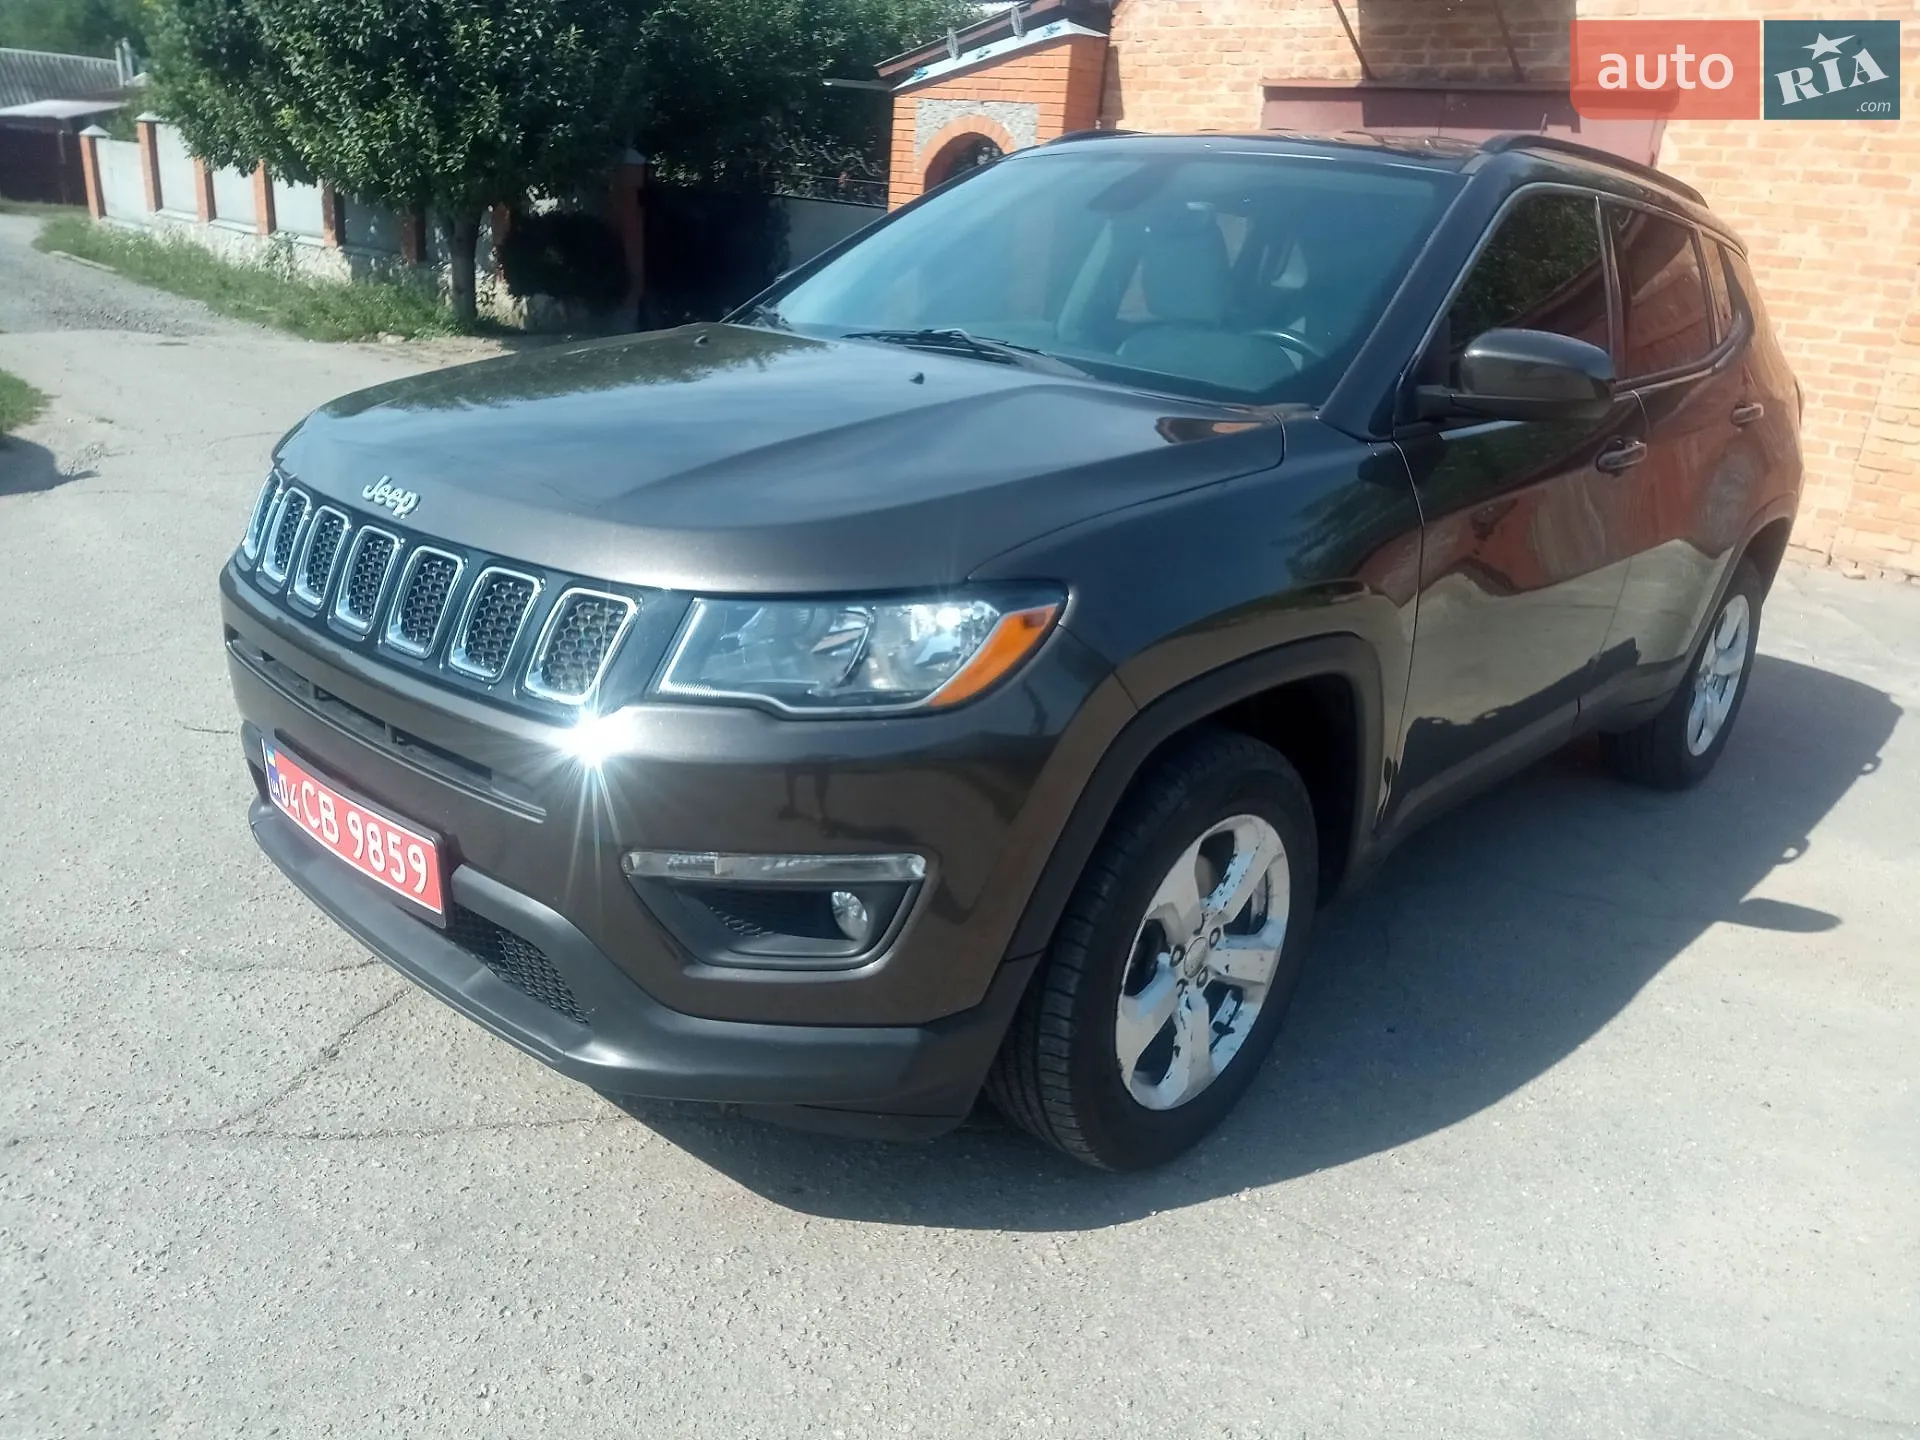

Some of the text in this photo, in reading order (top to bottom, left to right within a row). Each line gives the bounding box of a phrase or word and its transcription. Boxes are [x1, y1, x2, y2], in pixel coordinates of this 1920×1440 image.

[362, 475, 418, 518] Jeep
[271, 778, 280, 798] UA
[346, 810, 428, 895] 9859
